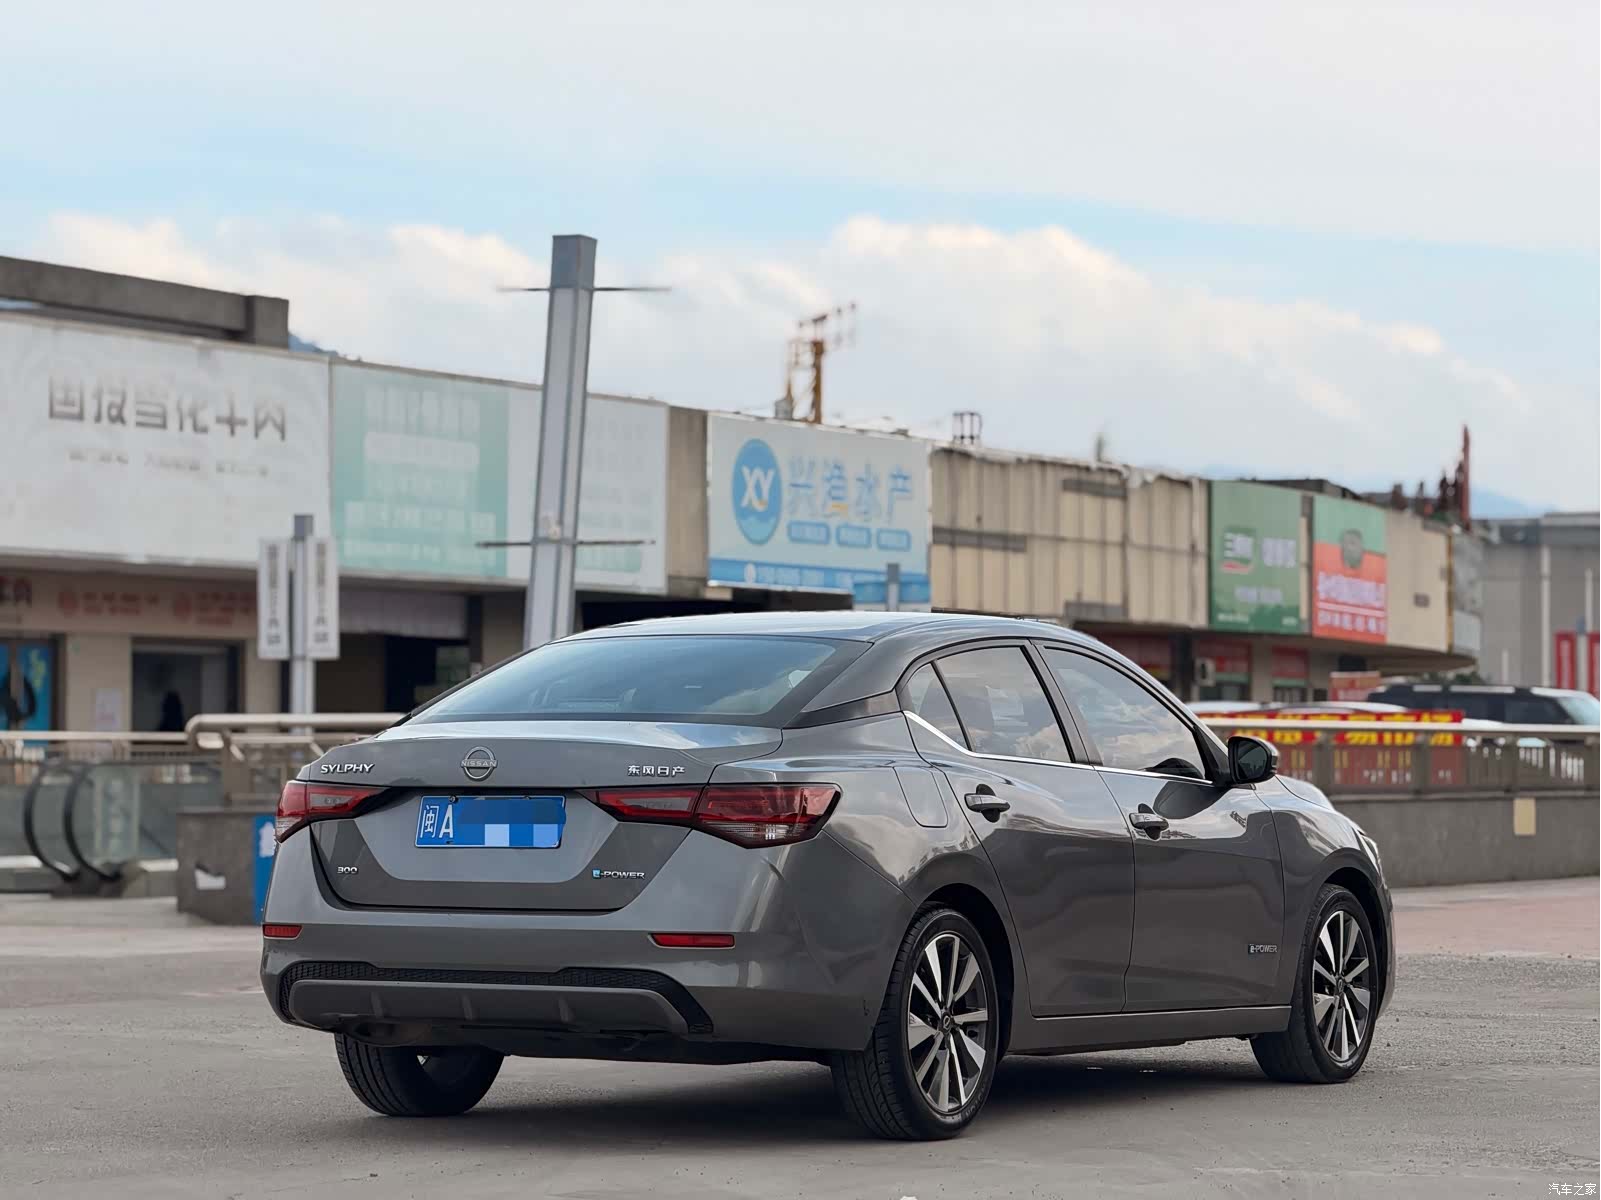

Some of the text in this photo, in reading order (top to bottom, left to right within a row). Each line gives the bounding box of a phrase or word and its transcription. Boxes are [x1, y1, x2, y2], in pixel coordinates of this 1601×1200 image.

[740, 465, 775, 512] XY
[320, 763, 375, 774] SYLPHY
[461, 759, 498, 768] NISSAN
[627, 765, 686, 777] 东风日产
[337, 866, 358, 874] 300
[1248, 944, 1278, 953] e-POWER
